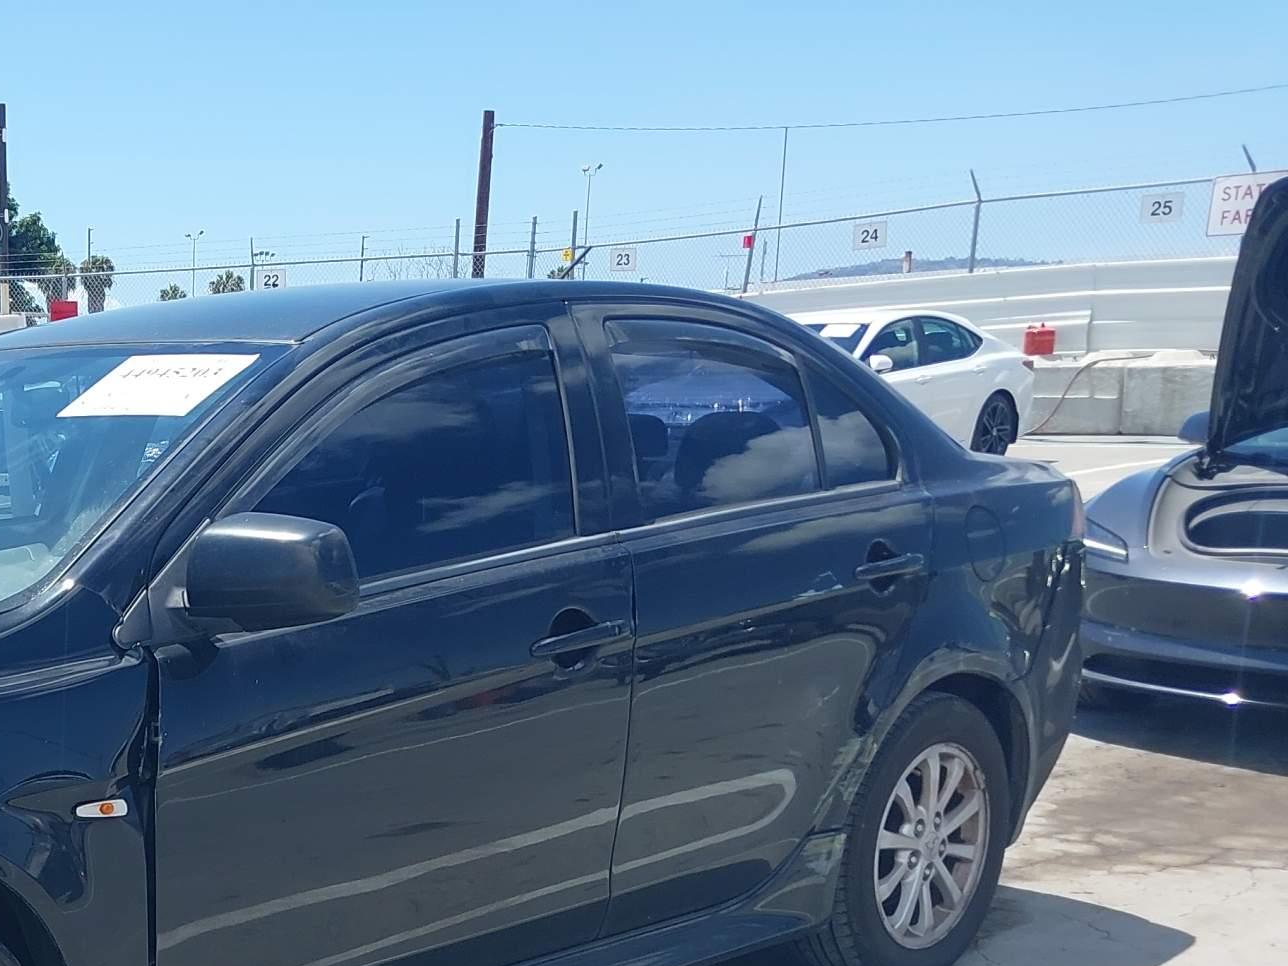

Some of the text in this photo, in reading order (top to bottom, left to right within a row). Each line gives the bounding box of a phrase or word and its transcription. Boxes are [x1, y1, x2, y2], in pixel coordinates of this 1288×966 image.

[1221, 183, 1266, 202] STAT
[1150, 200, 1173, 216] 25
[1220, 208, 1254, 226] FAR
[861, 228, 878, 243] 24
[616, 253, 630, 266] 23
[263, 274, 279, 287] 22
